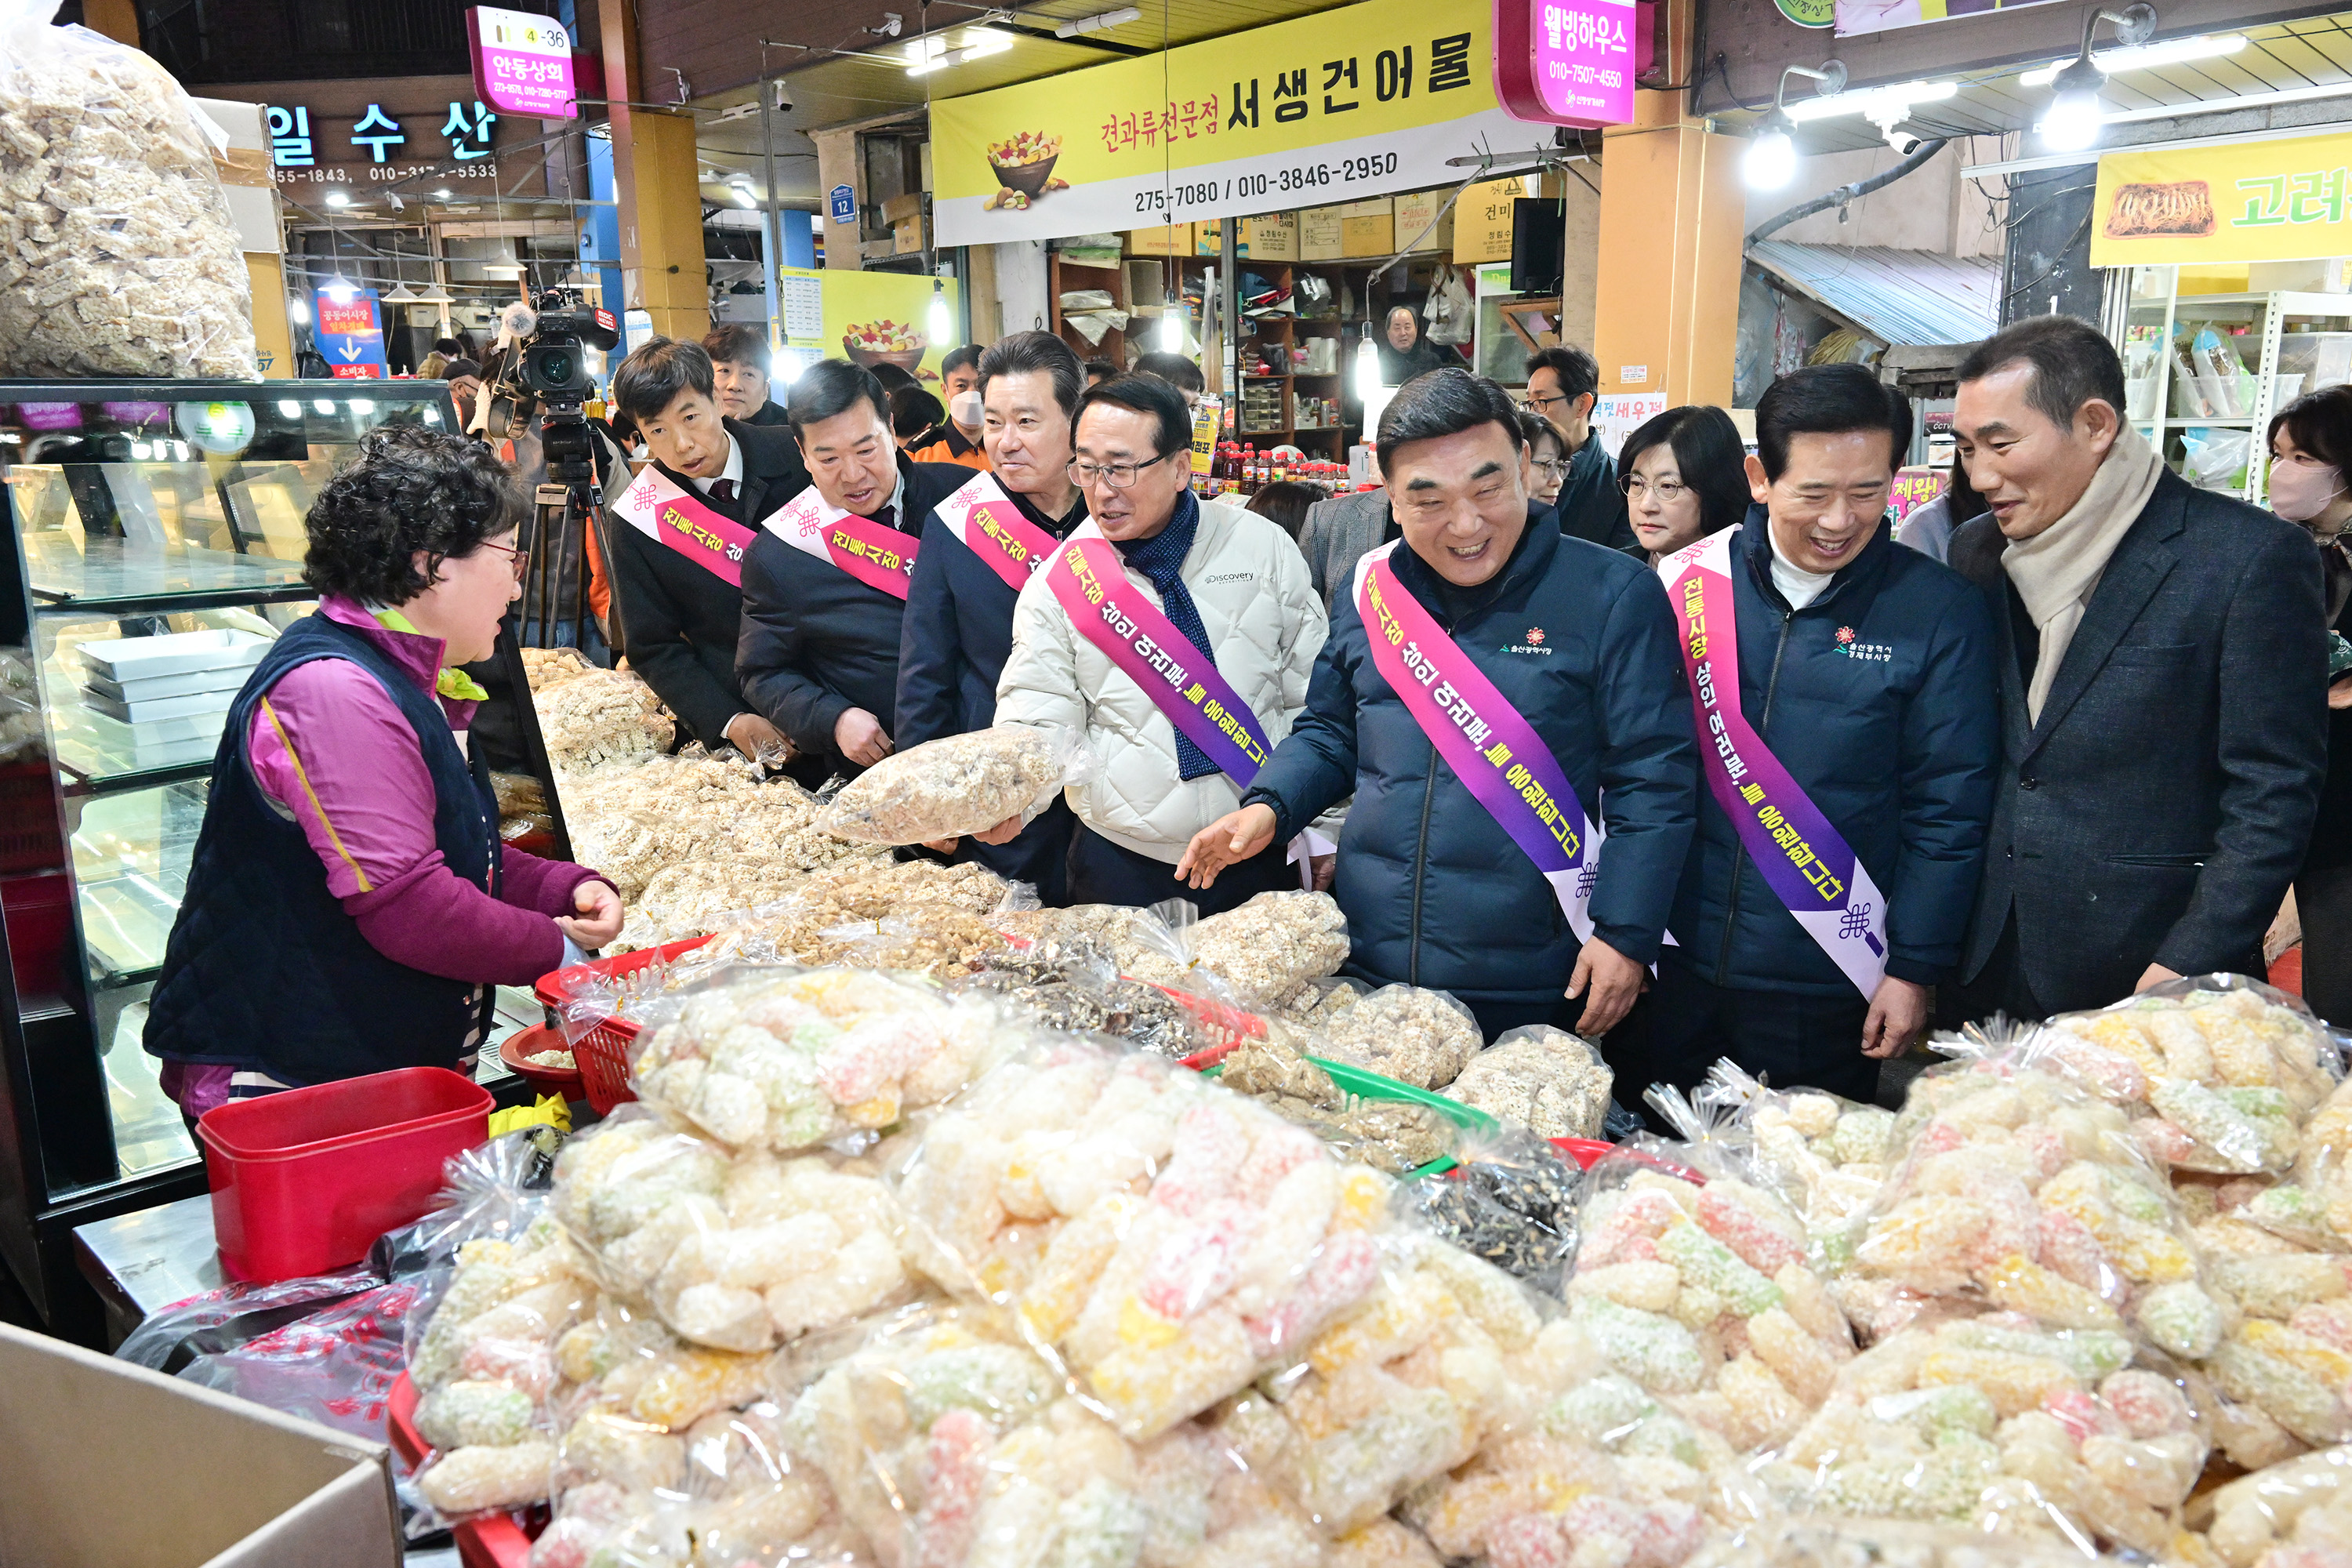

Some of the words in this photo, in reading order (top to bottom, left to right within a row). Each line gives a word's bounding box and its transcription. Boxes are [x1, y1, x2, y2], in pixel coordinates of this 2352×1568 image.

[1544, 5, 1628, 55] 웰빙하우스
[492, 56, 564, 82] 안동상회
[1549, 60, 1622, 89] 010-7507-4550
[1102, 93, 1218, 153] 견과류전문점
[1228, 32, 1472, 131] 서생건어물
[274, 168, 353, 183] 55-1843,
[1135, 181, 1218, 212] 275-7080
[1239, 152, 1398, 198] 010-3846-2950
[837, 200, 848, 213] 12
[2230, 165, 2352, 227] 고려
[323, 310, 368, 321] 공동어시장
[598, 317, 614, 327] NEWS
[339, 365, 367, 376] 소비자
[1192, 441, 1210, 454] 점포
[662, 506, 724, 552] 전통시장
[973, 507, 1027, 561] 전통시장
[832, 529, 900, 570] 전통시장
[1207, 572, 1254, 583] Discovery
[1065, 545, 1105, 605] 전통시장
[1101, 601, 1138, 640] 상인
[1134, 633, 1189, 693] 여러분,
[1183, 682, 1207, 706] 늘
[1683, 576, 1708, 659] 전통시장
[1510, 644, 1552, 655] 울산광역시장
[1848, 650, 1892, 662] 경제부시장
[1849, 643, 1893, 654] 울산광역시
[1695, 661, 1717, 709] 상인
[1367, 568, 1404, 646] 전통시장
[1402, 641, 1440, 687] 상인
[1433, 680, 1493, 752] 여러분,
[1483, 742, 1513, 768] 늘
[1505, 763, 1581, 859] 응원합니다
[1708, 710, 1748, 786] 여러분,
[1739, 782, 1766, 806] 늘
[1757, 805, 1844, 902] 응원합니다
